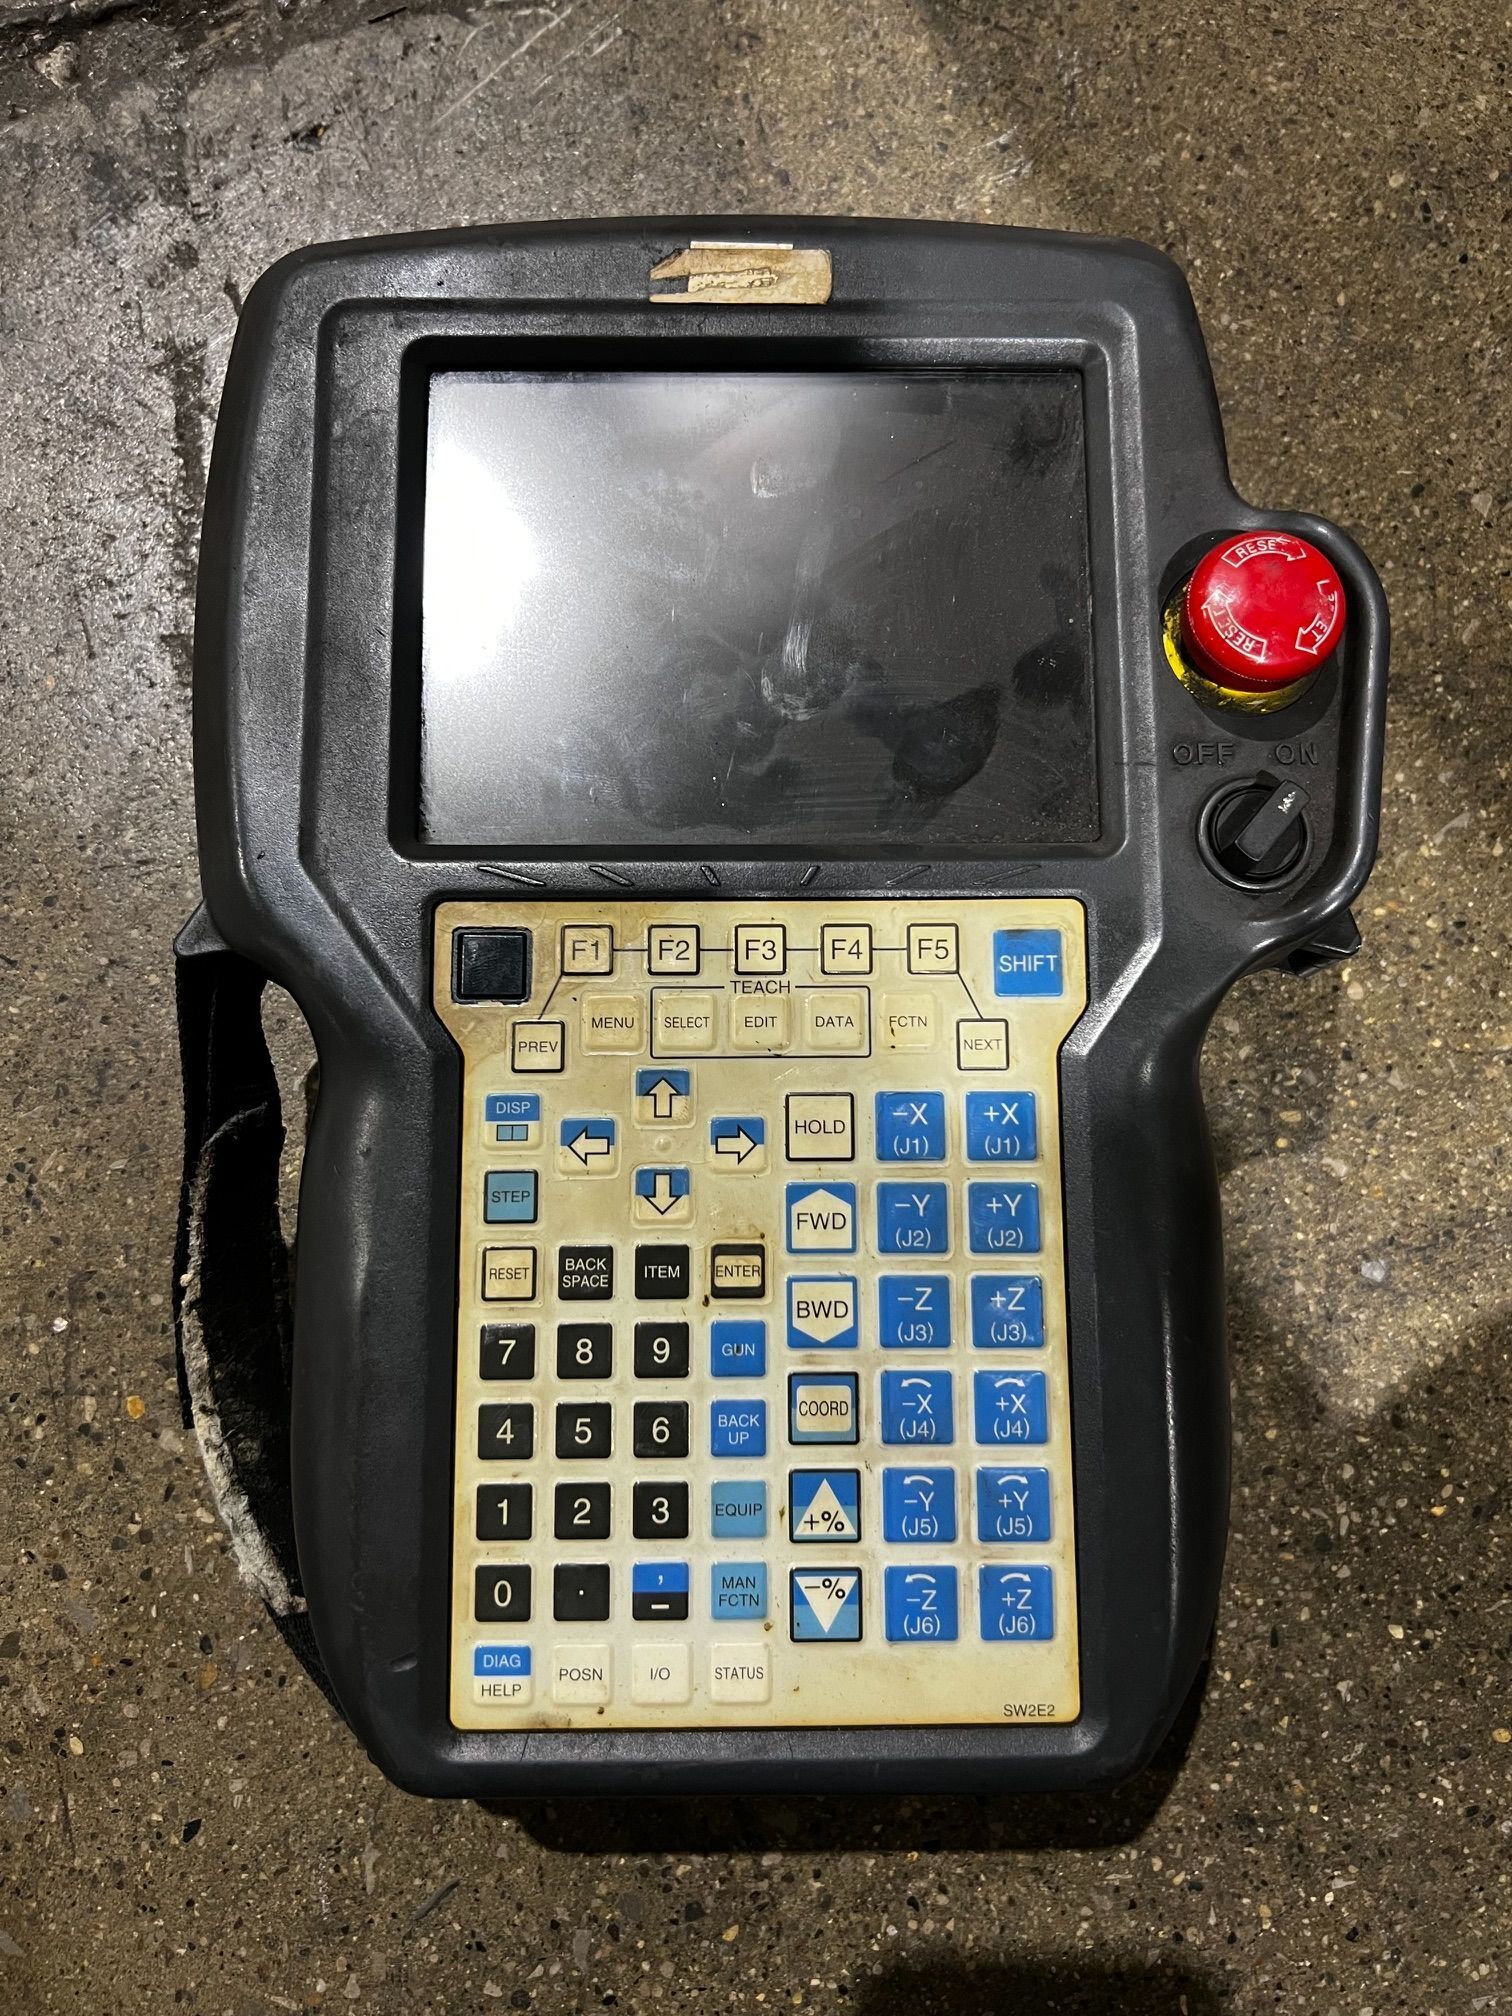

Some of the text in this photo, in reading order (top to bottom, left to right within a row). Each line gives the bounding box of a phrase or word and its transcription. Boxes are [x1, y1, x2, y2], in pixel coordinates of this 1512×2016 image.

[1173, 742, 1234, 765] OFF
[1275, 742, 1318, 765] ON
[572, 939, 600, 961] F1
[659, 940, 690, 960] F2
[745, 940, 777, 960] F3
[832, 939, 863, 959] F4
[918, 939, 949, 959] F5
[1000, 955, 1058, 973] SHIFT
[730, 980, 791, 994] TEACH
[592, 1017, 635, 1029] MENU
[664, 1017, 710, 1028] SELECT
[744, 1016, 777, 1028] EDIT
[815, 1016, 854, 1028] DATA
[889, 1016, 927, 1028] FCTN
[518, 1041, 558, 1053] PREV
[963, 1039, 1002, 1051] NEXT
[496, 1102, 531, 1114] DISP
[984, 1102, 1019, 1126] +X
[794, 1120, 846, 1134] HOLD
[894, 1136, 928, 1156] (J1)
[985, 1136, 1020, 1156] (J1)
[491, 1191, 530, 1203] STEP
[986, 1194, 1022, 1216] +Y
[797, 1213, 846, 1230] FWD
[896, 1228, 931, 1248] (J2)
[988, 1228, 1023, 1248] (J2)
[489, 1268, 529, 1280] RESET
[566, 1259, 607, 1271] BACK
[644, 1266, 680, 1278] ITEM
[715, 1265, 760, 1277] ENTER
[562, 1275, 608, 1288] SPACE
[990, 1288, 1025, 1310] +Z
[797, 1301, 848, 1318] BWD
[898, 1322, 933, 1342] (J3)
[990, 1322, 1026, 1342] (J3)
[498, 1340, 516, 1365] 7
[576, 1339, 593, 1364] 8
[653, 1337, 670, 1363] 9
[722, 1343, 755, 1356] GUN
[799, 1401, 848, 1416] COORD
[996, 1394, 1026, 1414] +X
[575, 1418, 592, 1444] 5
[652, 1417, 670, 1443] 6
[718, 1415, 759, 1427] BACK
[900, 1418, 936, 1439] (J4)
[993, 1418, 1030, 1439] (J4)
[496, 1419, 514, 1444] 4
[729, 1432, 749, 1444] UP
[573, 1498, 591, 1524] 2
[652, 1497, 669, 1524] 3
[715, 1504, 762, 1517] EQUIP
[998, 1491, 1029, 1511] +Y
[497, 1499, 507, 1525] 1
[804, 1511, 844, 1532] +%
[902, 1516, 938, 1537] (J5)
[996, 1516, 1032, 1537] (J5)
[722, 1577, 756, 1588] MAN
[494, 1580, 512, 1607] 0
[719, 1594, 759, 1607] FCTN
[1002, 1589, 1032, 1610] +Z
[903, 1614, 940, 1636] (J6)
[999, 1614, 1036, 1635] (J6)
[483, 1655, 521, 1668] DIAG
[559, 1669, 603, 1681] POSN
[650, 1668, 670, 1680] I/O
[715, 1667, 764, 1680] STATUS
[481, 1684, 522, 1696] HELP
[1004, 1705, 1055, 1717] SW2E2
